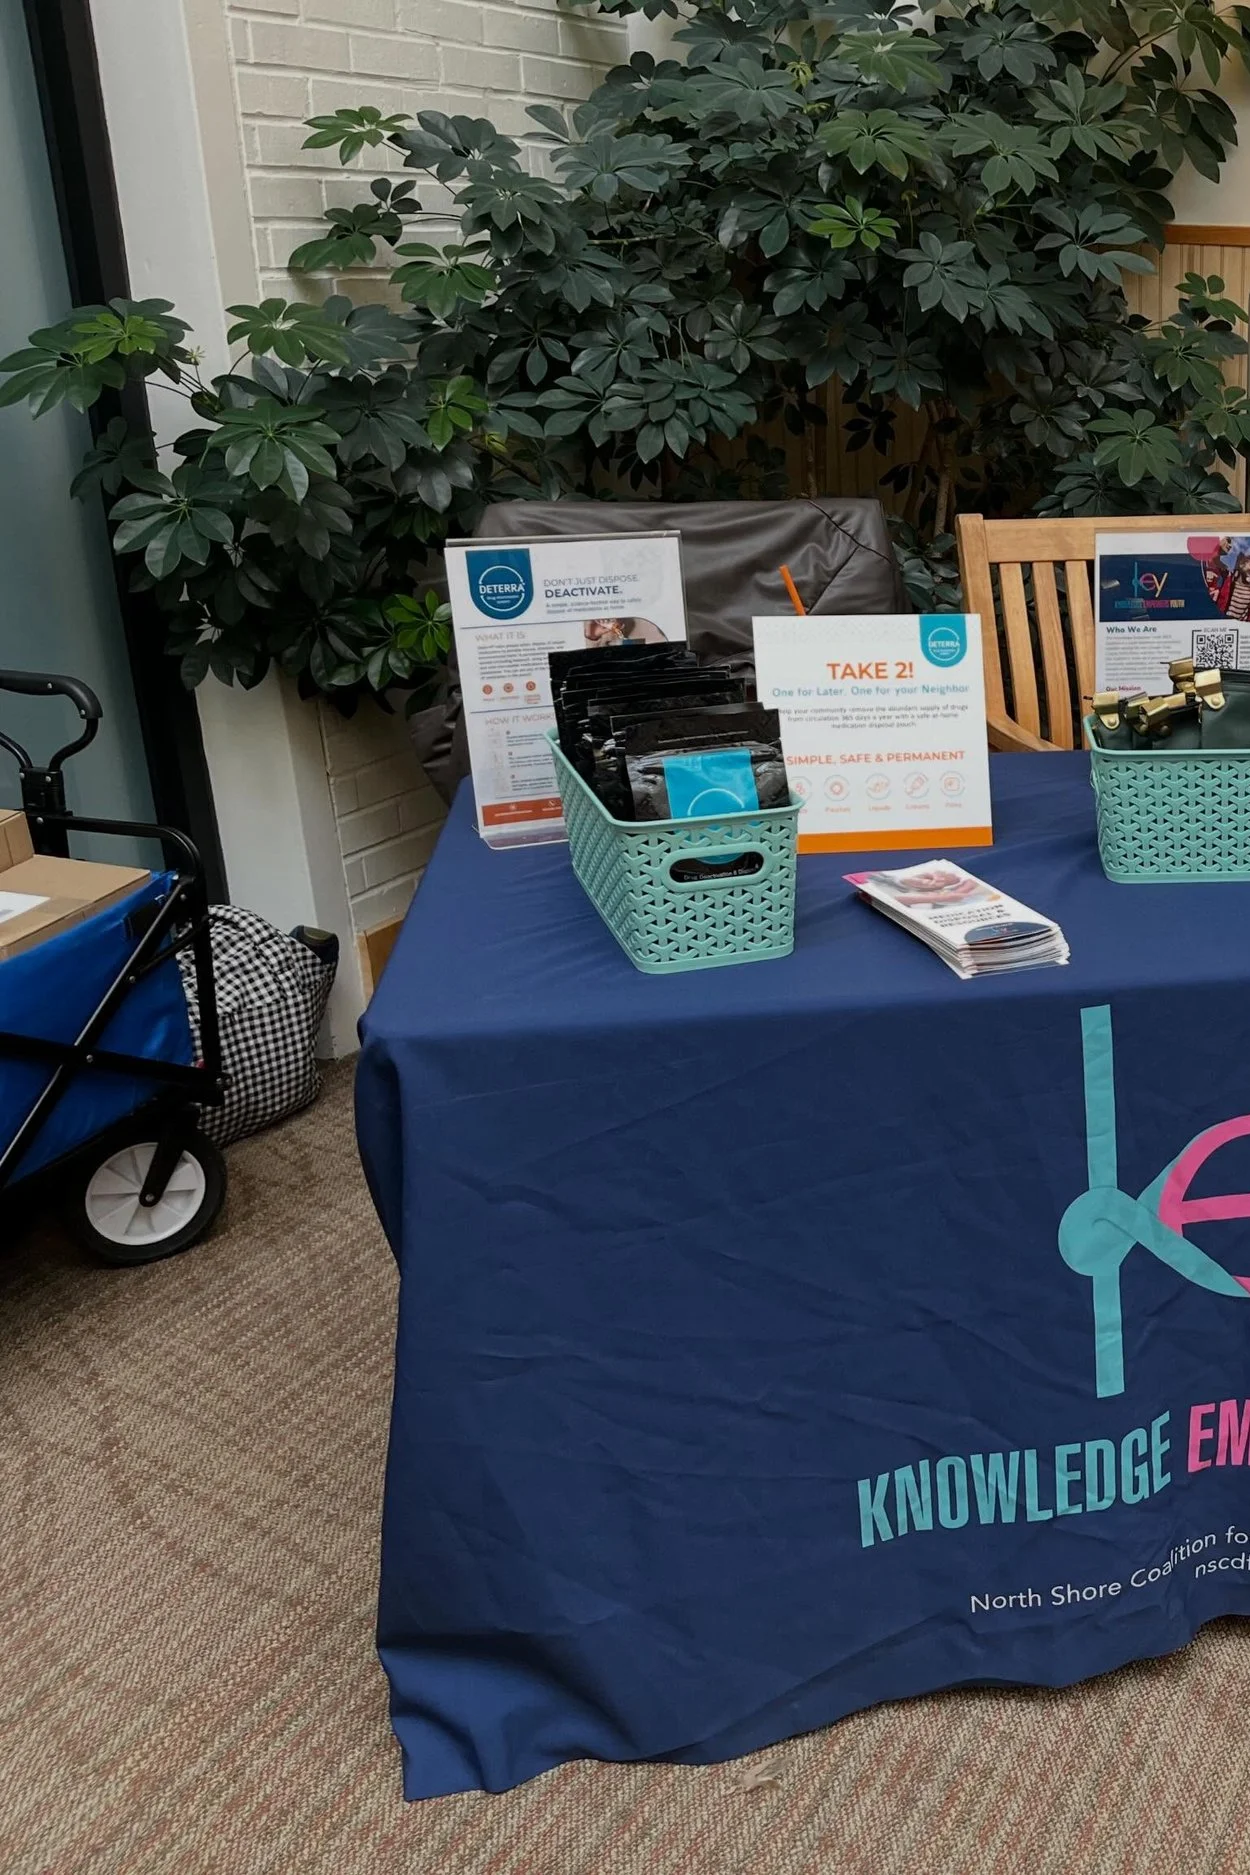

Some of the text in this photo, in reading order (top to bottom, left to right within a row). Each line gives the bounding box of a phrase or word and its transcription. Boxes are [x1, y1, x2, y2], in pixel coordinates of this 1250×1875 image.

[544, 577, 572, 587] DON'T
[574, 576, 596, 586] JUST
[479, 582, 525, 595] DETERRA
[545, 585, 623, 598] DEACTIVATE.
[1106, 625, 1157, 633] Who We Are
[475, 632, 504, 642] WHAT
[506, 631, 514, 640] IT
[827, 661, 915, 680] TAKE 2!
[772, 687, 794, 697] One
[797, 686, 813, 697] for
[851, 685, 873, 695] One
[875, 684, 891, 694] for
[894, 685, 917, 697] your
[921, 683, 970, 696] Neighbor
[1106, 683, 1142, 693] Our Mission
[485, 716, 508, 725] HOW
[839, 753, 872, 764] SAFE
[875, 752, 885, 762] &
[887, 750, 965, 762] PERMANENT
[857, 1410, 1171, 1549] KNOWLEDGE
[970, 1588, 1042, 1613] North
[1050, 1581, 1122, 1606] Shore
[1130, 1529, 1216, 1587] Coalition
